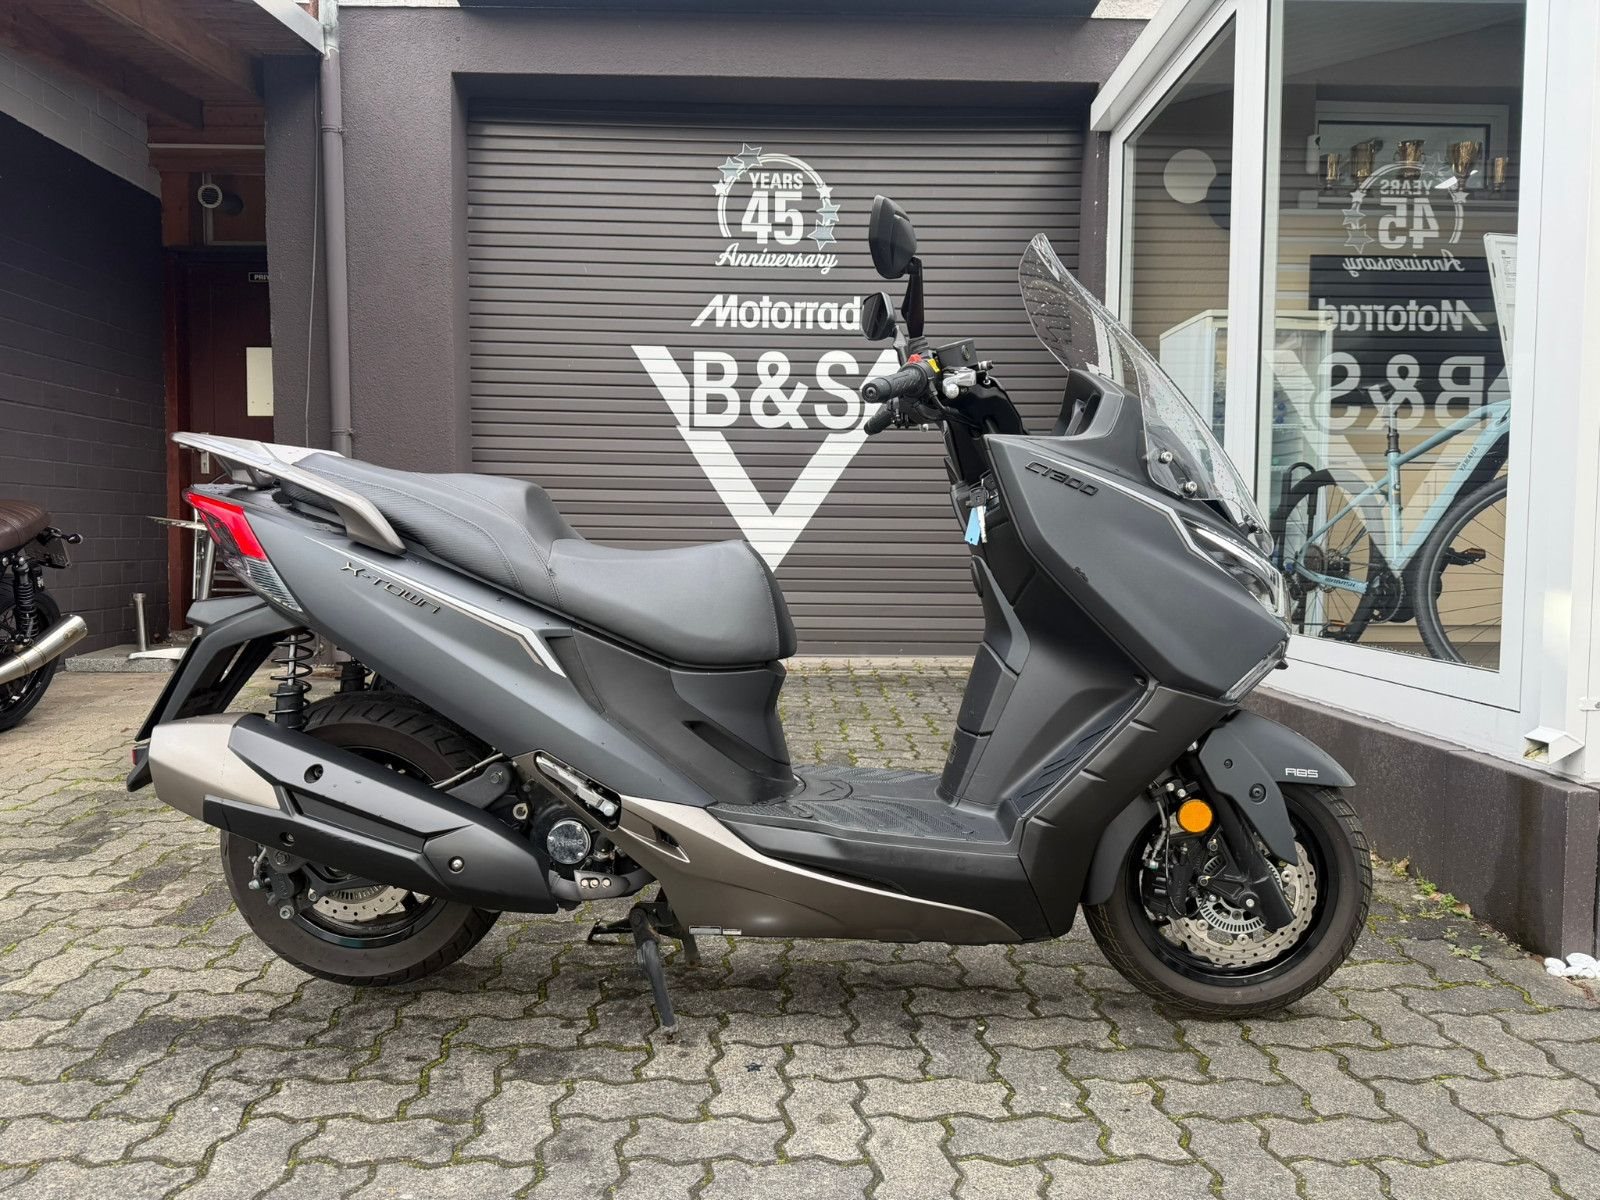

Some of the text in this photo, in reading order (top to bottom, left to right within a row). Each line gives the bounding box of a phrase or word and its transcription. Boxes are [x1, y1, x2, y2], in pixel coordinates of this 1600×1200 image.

[749, 172, 804, 189] YEARS
[741, 190, 804, 245] 45
[714, 242, 838, 275] Anniversary
[690, 294, 861, 331] Motorrad
[693, 350, 861, 430] B&S
[1025, 461, 1099, 496] CT300
[1285, 767, 1319, 778] ABS
